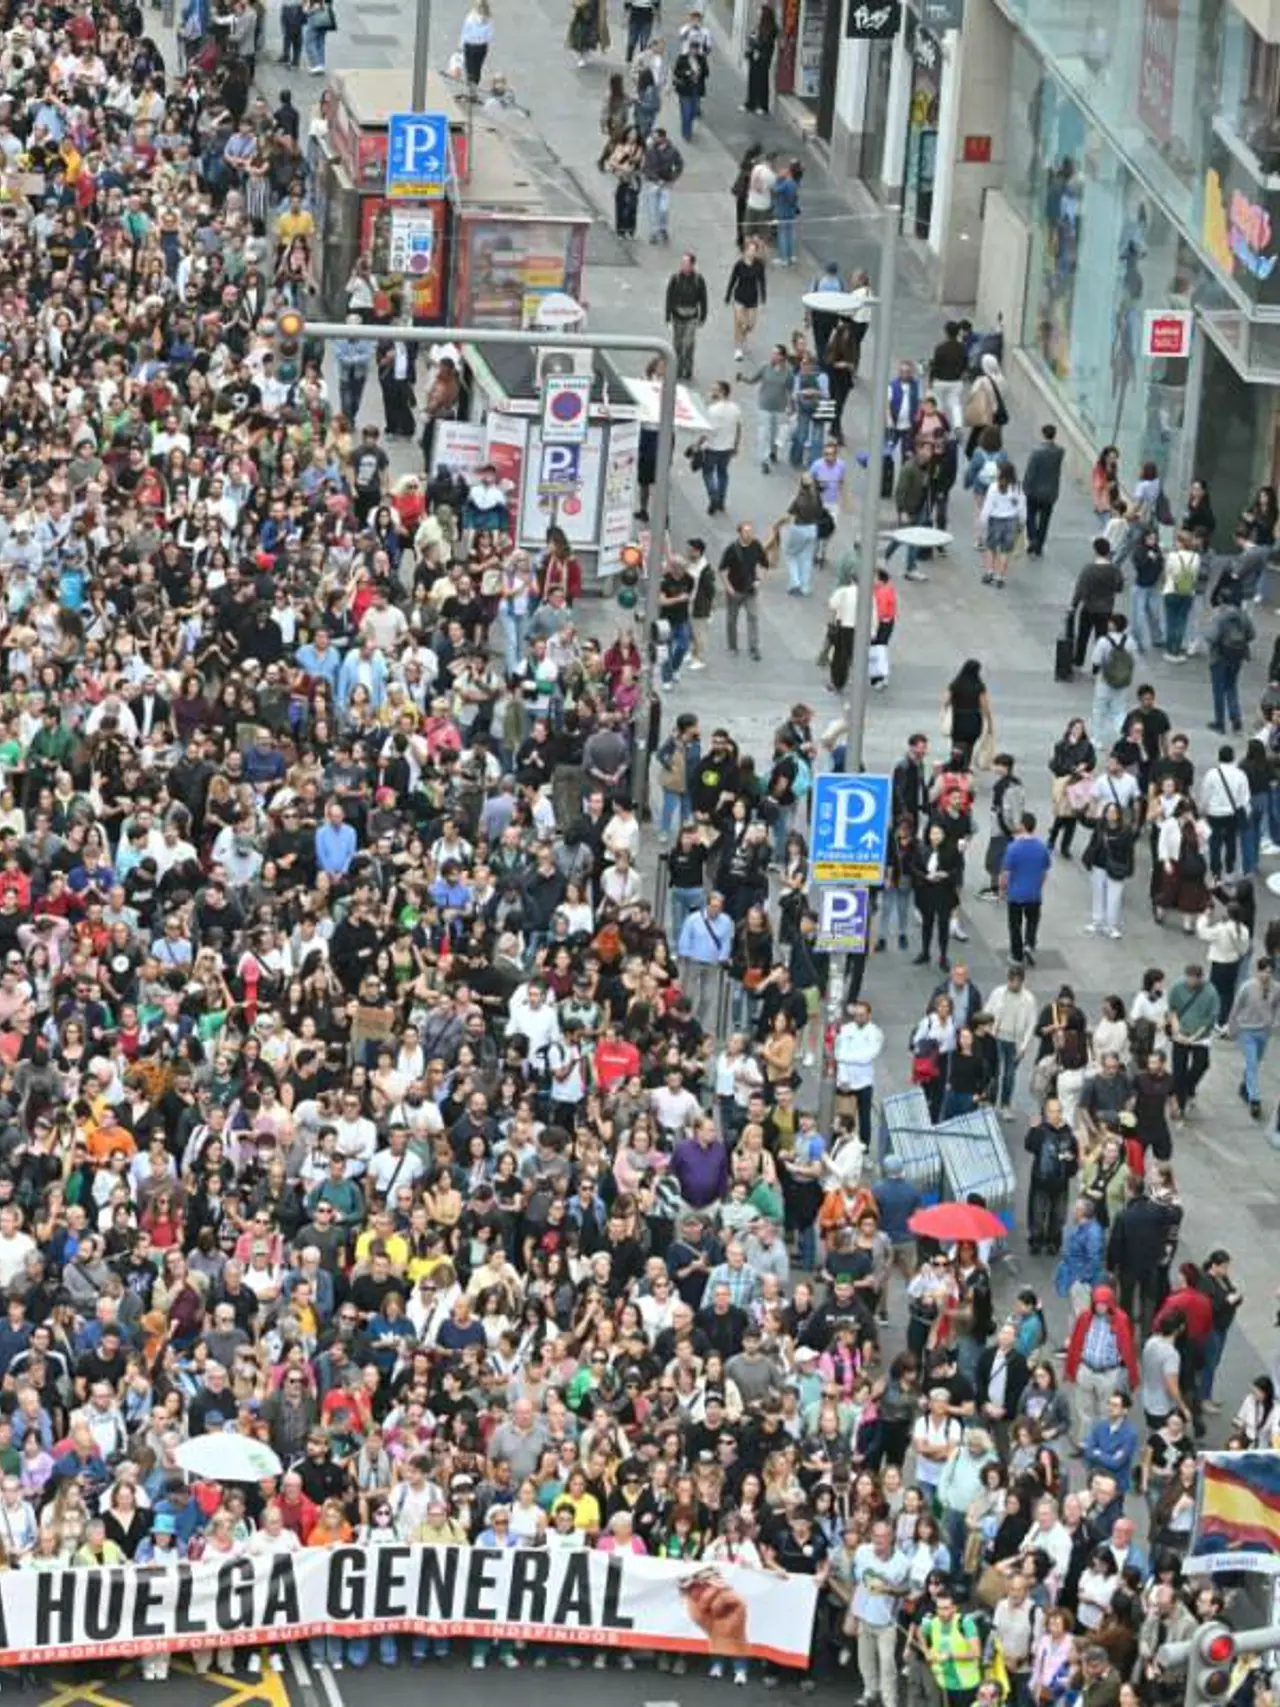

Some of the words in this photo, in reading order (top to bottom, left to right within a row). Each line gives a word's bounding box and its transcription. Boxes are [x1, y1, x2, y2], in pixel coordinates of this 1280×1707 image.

[399, 123, 437, 173] P
[542, 446, 573, 480] P
[827, 788, 877, 850] P
[822, 890, 858, 932] P
[36, 1552, 300, 1645] HUELGA
[326, 1546, 634, 1628] GENERAL
